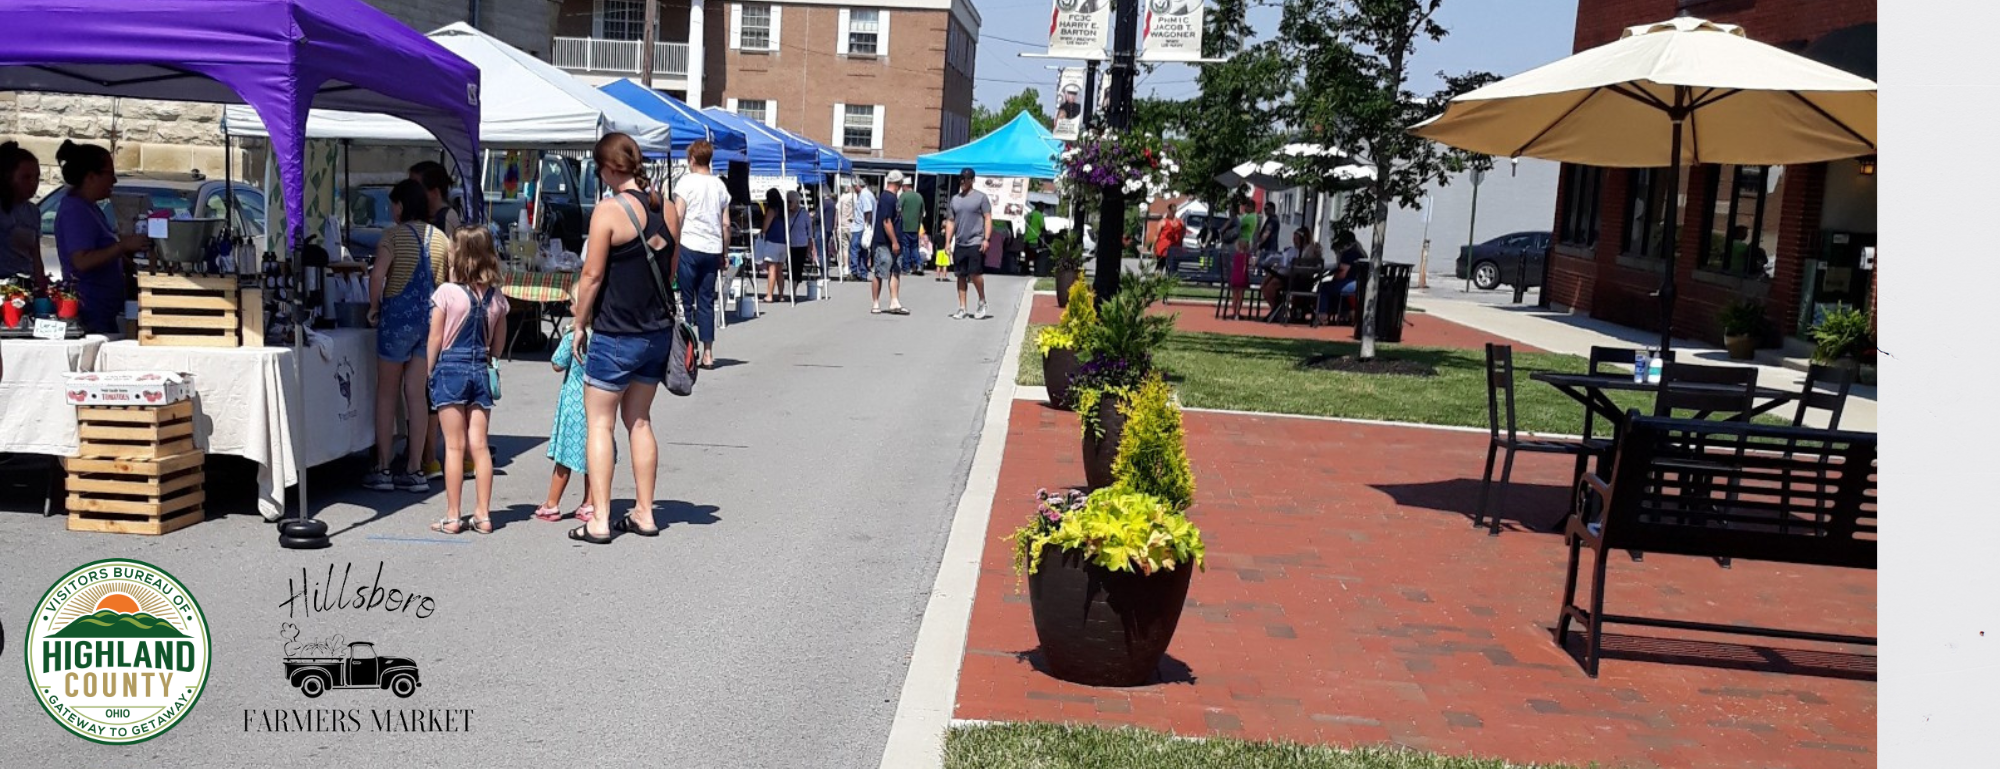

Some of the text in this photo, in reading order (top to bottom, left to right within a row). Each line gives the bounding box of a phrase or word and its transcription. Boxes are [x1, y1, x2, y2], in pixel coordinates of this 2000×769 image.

[1058, 21, 1100, 30] HARRY E.
[1060, 28, 1097, 36] BARTON
